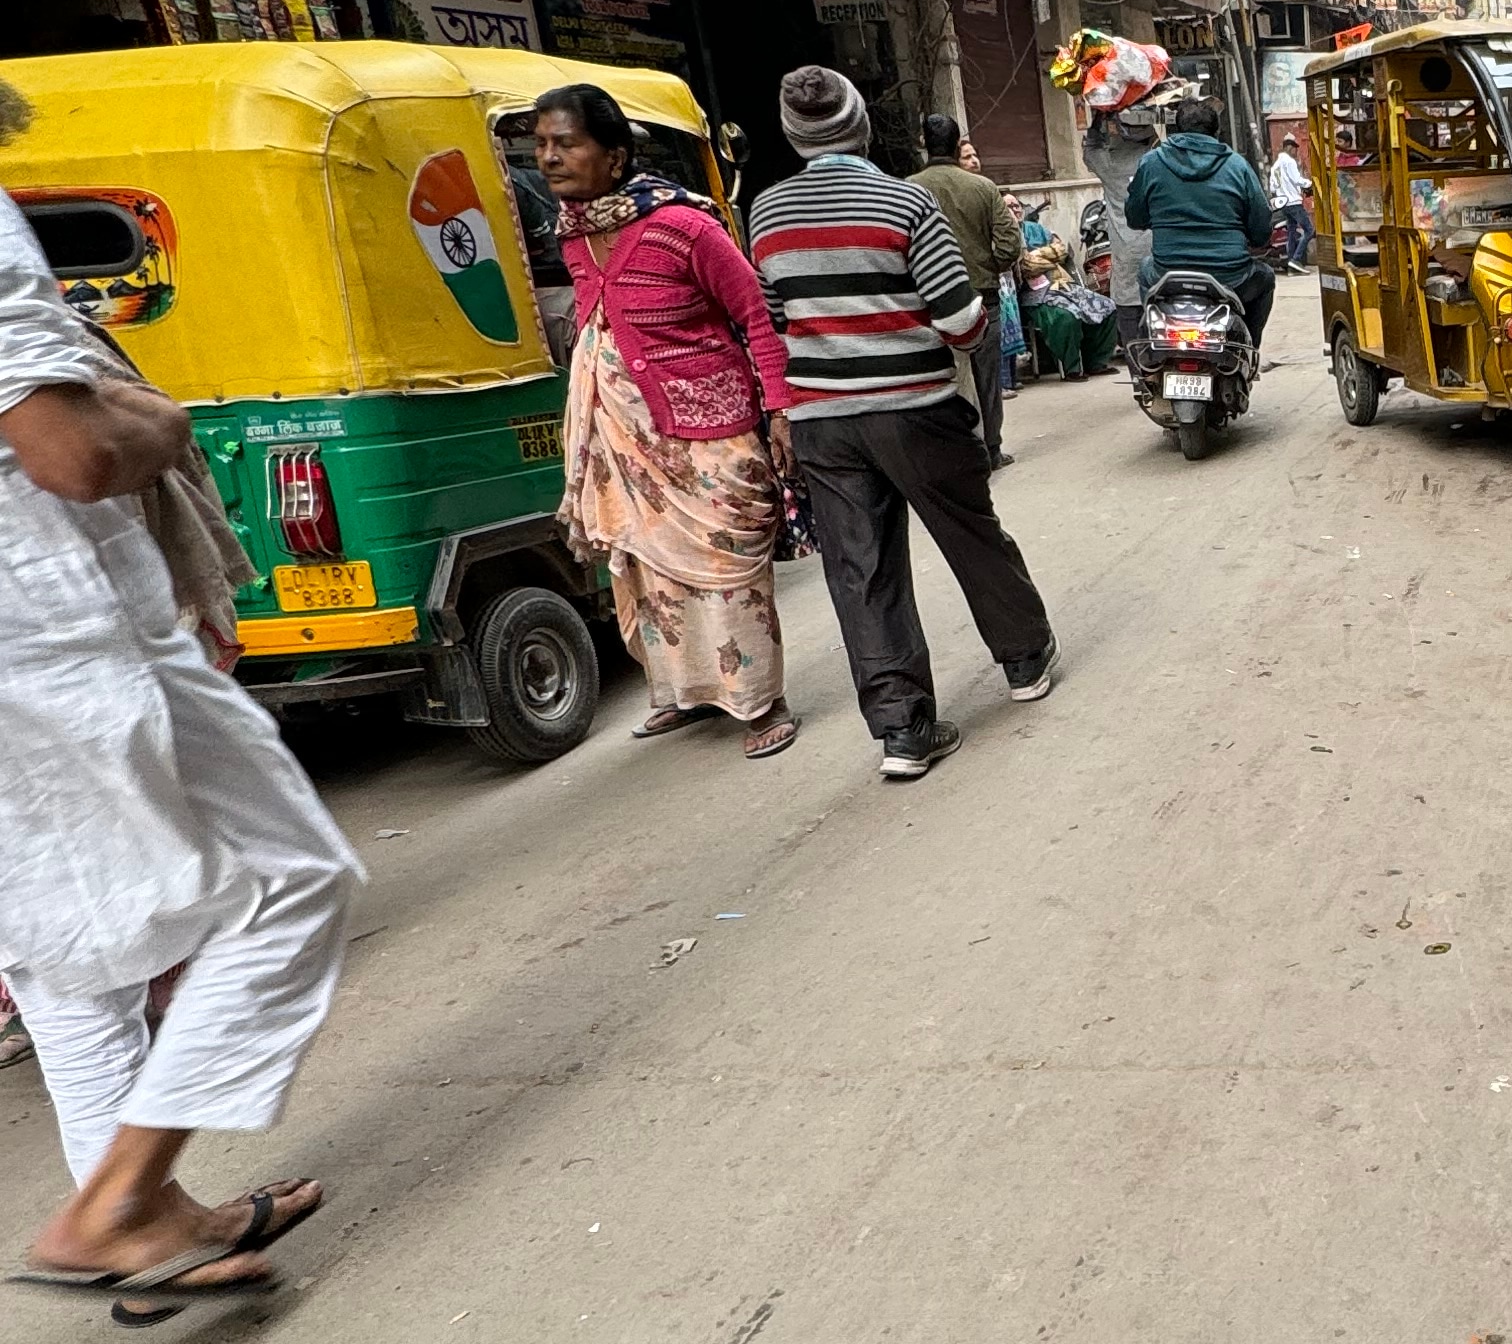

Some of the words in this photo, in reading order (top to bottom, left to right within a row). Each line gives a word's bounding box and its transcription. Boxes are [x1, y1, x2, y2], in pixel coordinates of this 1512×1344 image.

[820, 2, 885, 22] RECEPTION
[522, 438, 559, 459] 8388
[302, 588, 355, 607] 8388
